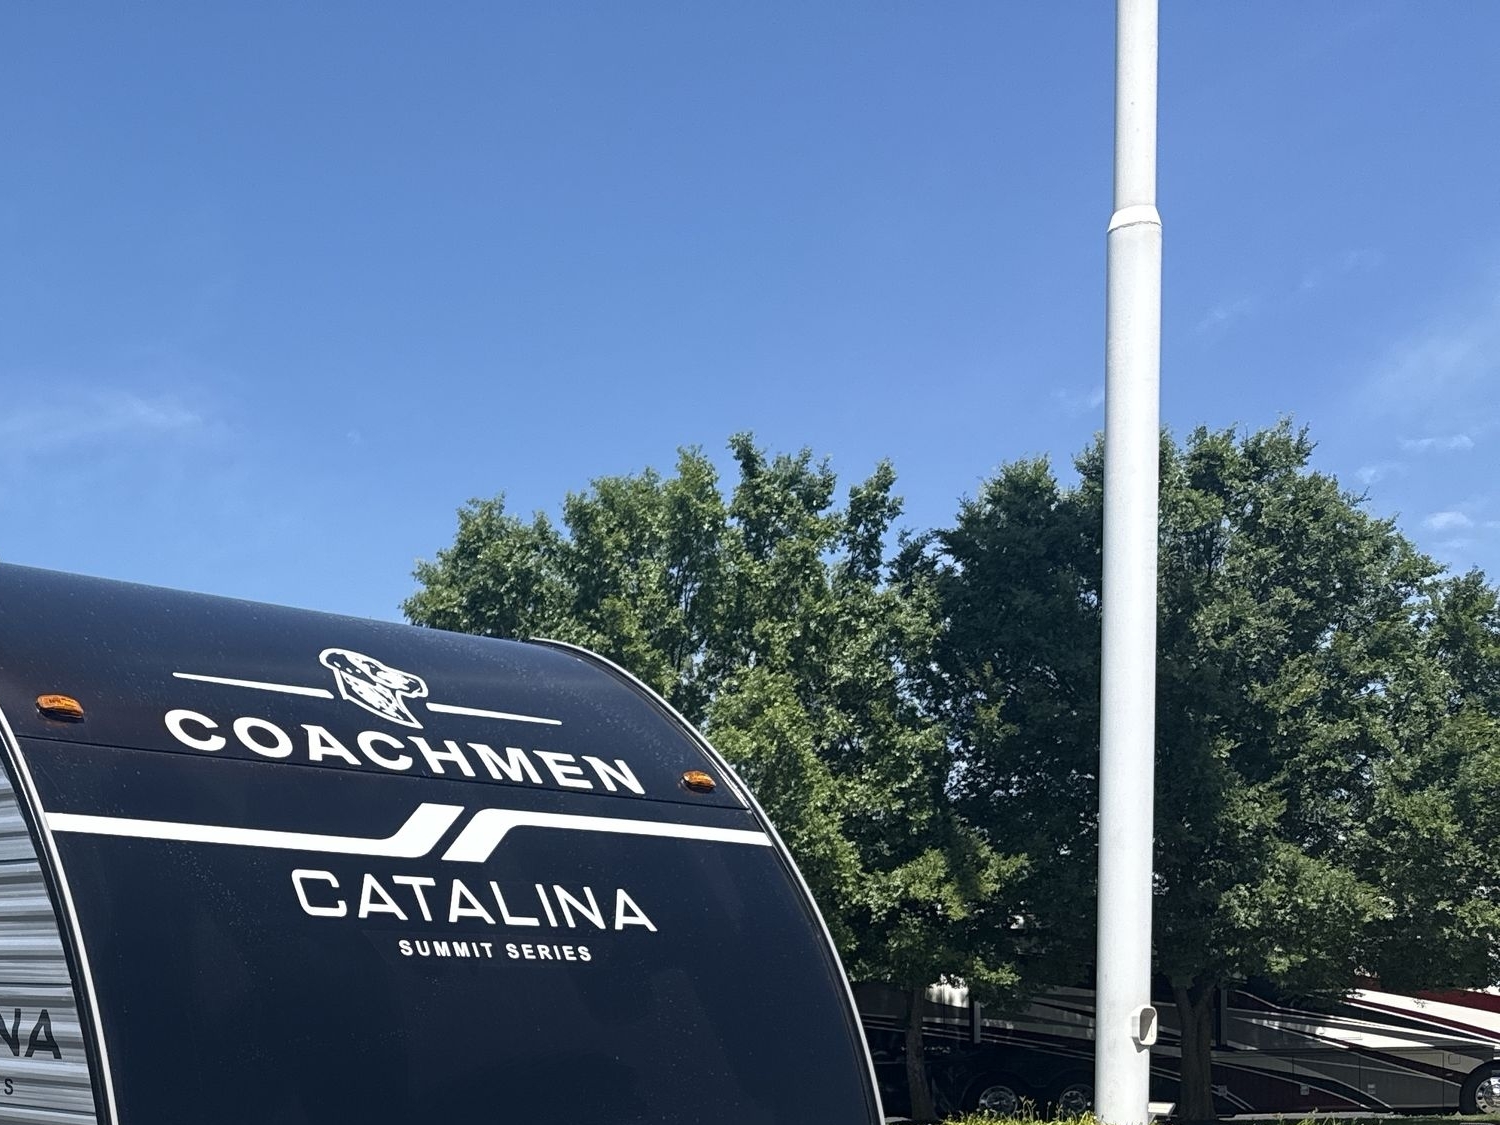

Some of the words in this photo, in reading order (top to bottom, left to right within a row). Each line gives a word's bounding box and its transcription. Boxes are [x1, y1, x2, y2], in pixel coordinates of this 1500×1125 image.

[164, 709, 646, 795] COACHMEN
[291, 868, 658, 932] CATALINA
[398, 939, 493, 958] SUMMIT
[505, 943, 592, 962] SERIES
